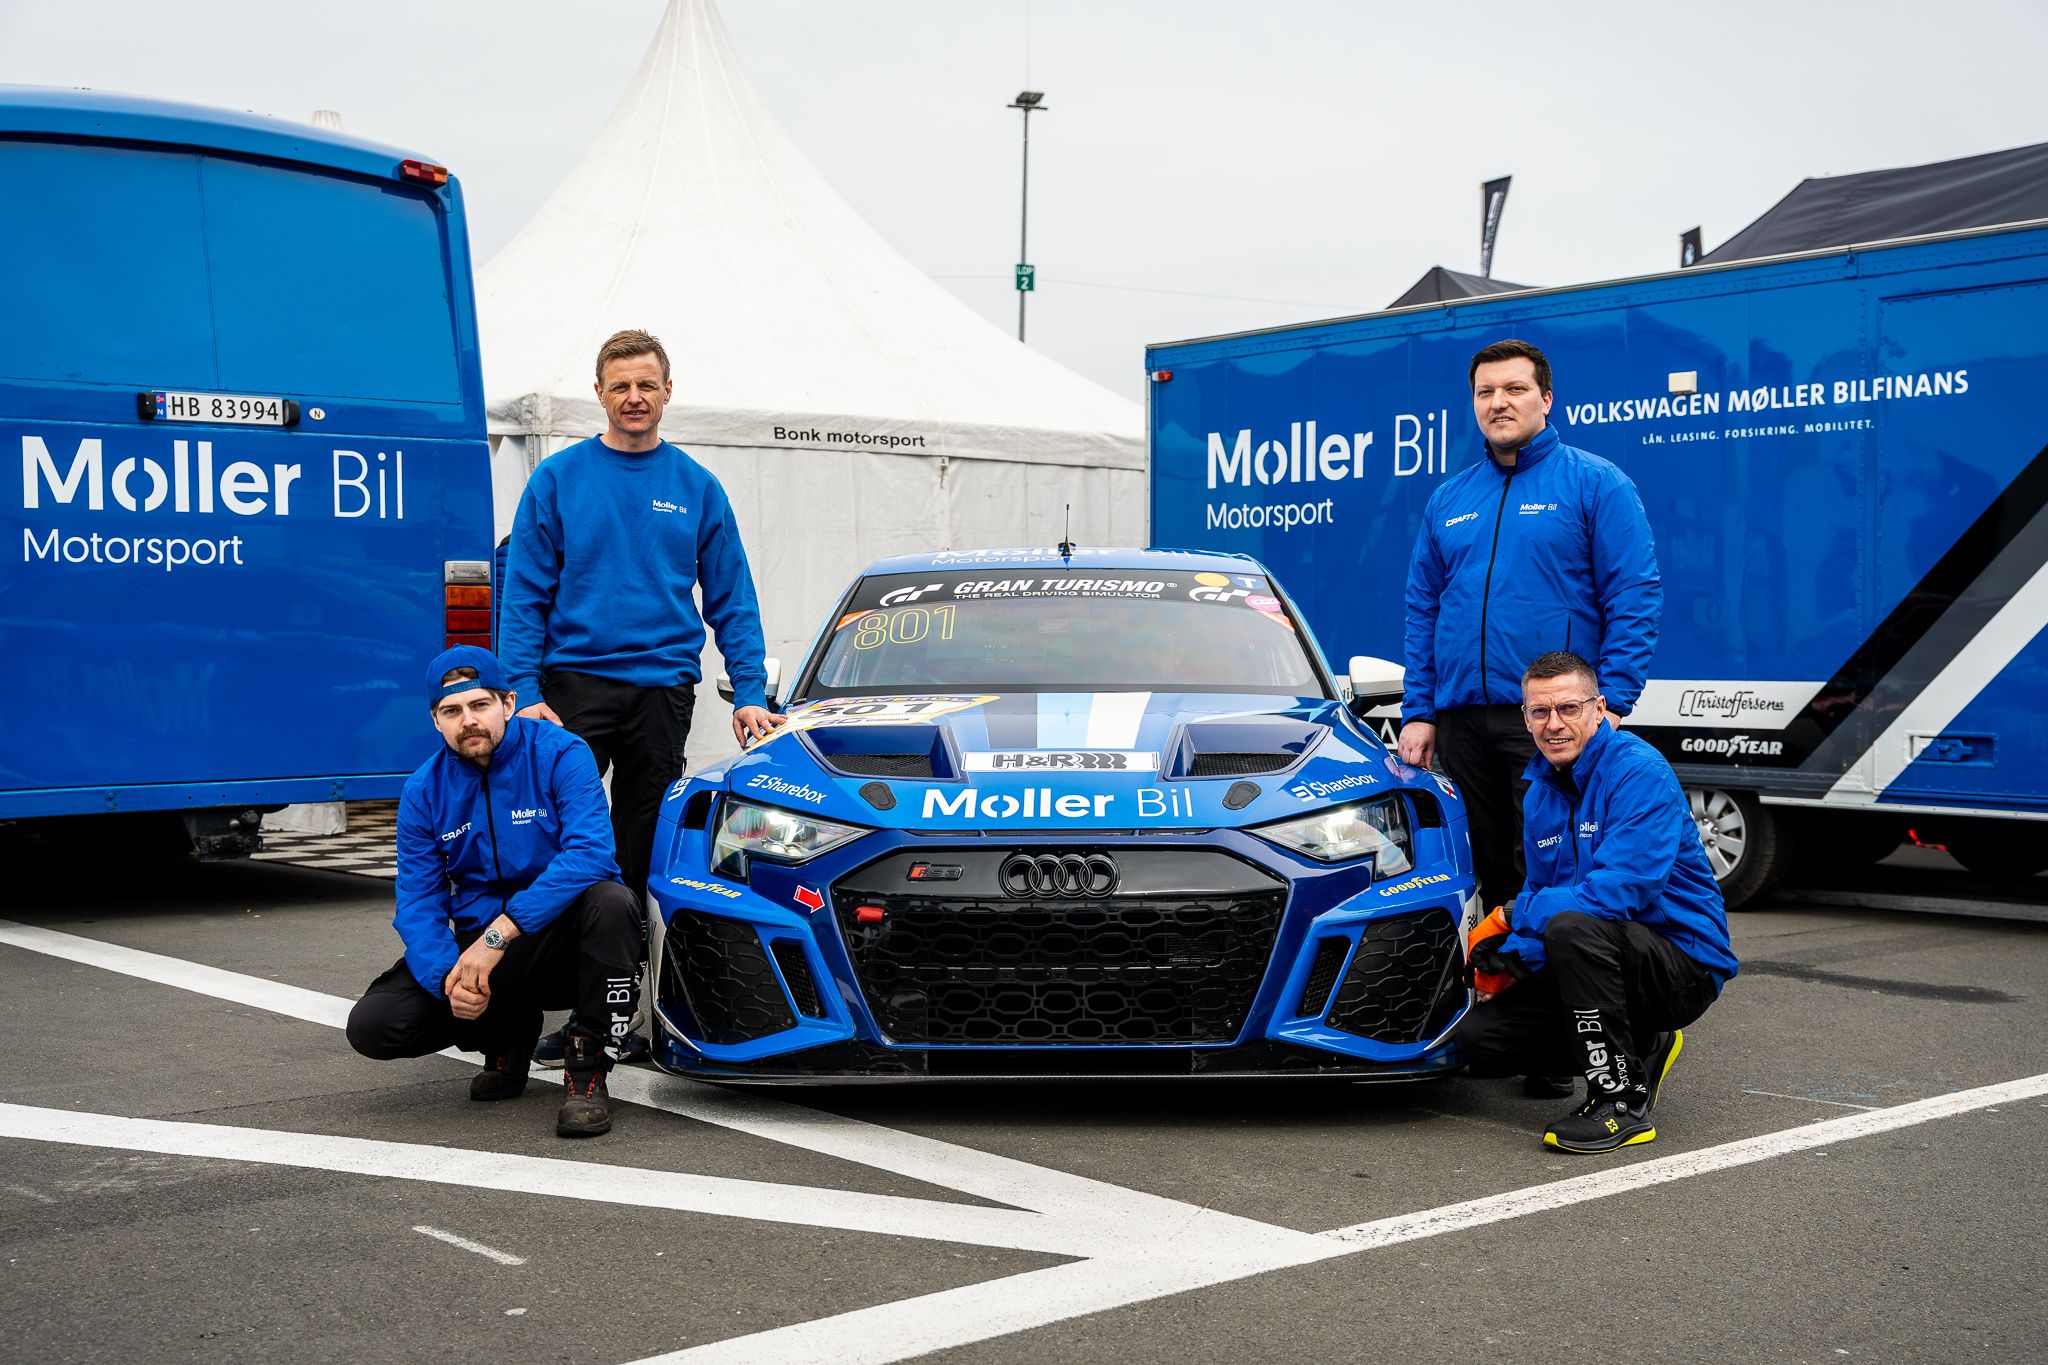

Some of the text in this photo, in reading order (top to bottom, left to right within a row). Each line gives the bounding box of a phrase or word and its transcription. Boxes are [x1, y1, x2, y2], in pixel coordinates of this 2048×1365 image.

[1021, 276, 1030, 290] 2
[171, 395, 279, 421] HB 83994
[1565, 369, 1969, 426] VOLKSWAGEN MØLLER BILFINANS
[774, 426, 925, 448] Bonk motorsport
[1394, 409, 1447, 477] Bil
[333, 449, 403, 519] Bil
[1206, 498, 1334, 532] Motorsport
[23, 527, 243, 571] Motorsport
[953, 579, 1034, 594] GRAN
[1081, 590, 1160, 599] SIMULATOR
[853, 604, 956, 650] 801
[799, 702, 934, 720] 801
[1681, 735, 1783, 758] GOODYEAR
[761, 775, 827, 804] Sharebox
[1311, 772, 1379, 796] Sharebox
[1137, 788, 1193, 818] Bil
[441, 822, 472, 842] CRAFT
[1537, 835, 1558, 848] CRAFT
[670, 876, 742, 899] GOODYEAR
[1379, 873, 1452, 897] GOODYEAR
[606, 977, 631, 1003] Bil
[1573, 1008, 1603, 1034] Bil
